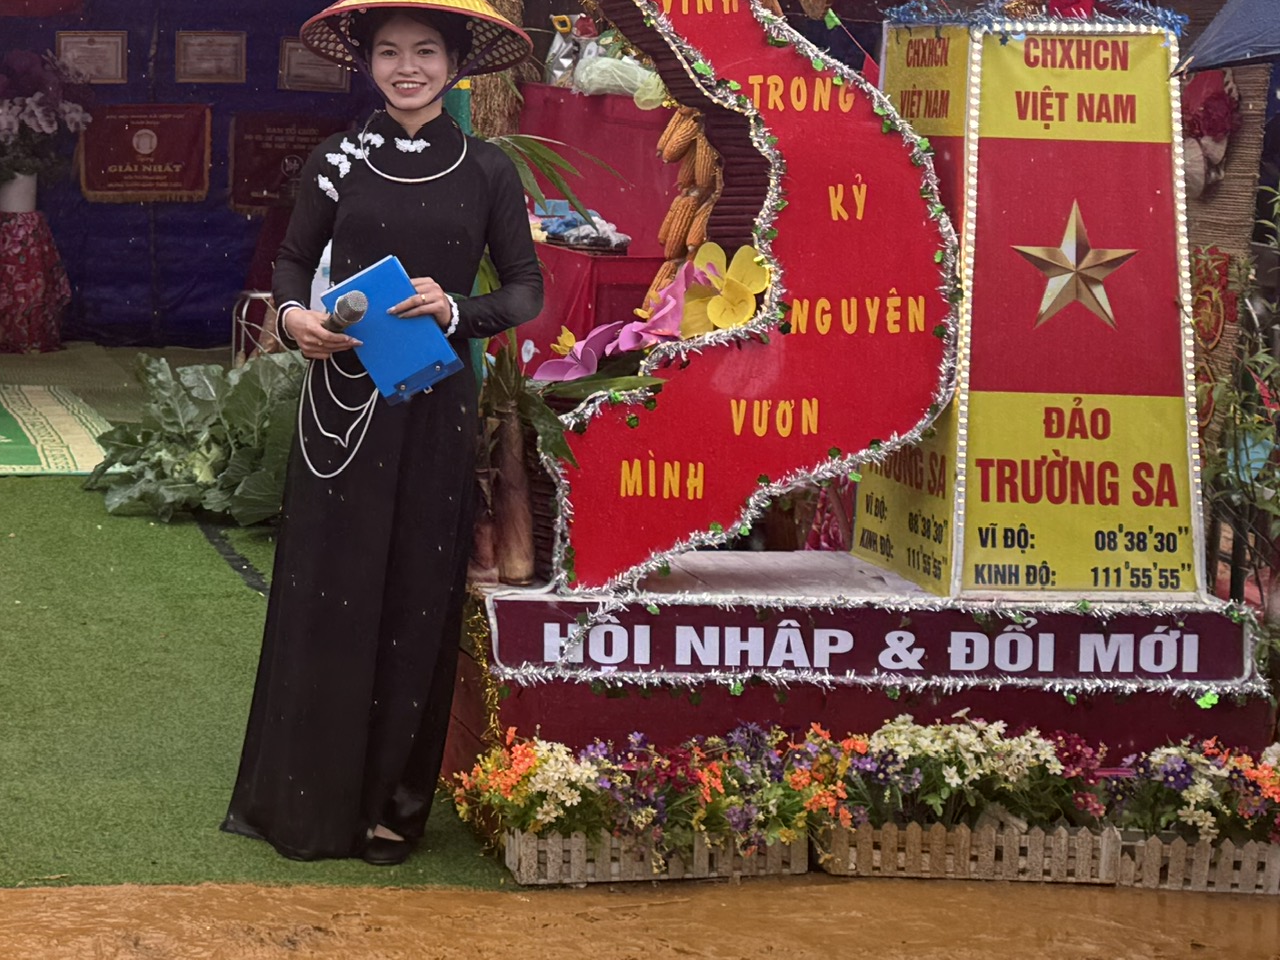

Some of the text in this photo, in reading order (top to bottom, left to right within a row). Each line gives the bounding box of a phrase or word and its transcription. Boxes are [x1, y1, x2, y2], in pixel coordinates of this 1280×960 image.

[907, 37, 948, 68] CHXHCN
[1023, 38, 1129, 72] CHXHCN
[748, 75, 855, 112] TRONG
[923, 89, 950, 119] NAM
[1015, 86, 1136, 130] VIỆT NAM
[828, 174, 867, 221] KỶ
[790, 288, 926, 335] NGUYÊN
[730, 398, 819, 437] VƯƠN
[1043, 397, 1111, 440] ĐẢO
[620, 450, 705, 499] MÌNH
[927, 451, 947, 500] SA
[975, 449, 1179, 507] TRƯỜNG SA
[977, 525, 998, 550] VĨ
[1003, 523, 1036, 555] ĐỘ:
[974, 564, 1019, 586] KINH
[1025, 561, 1057, 591] ĐỘ:
[543, 614, 651, 673] HỘI
[878, 631, 925, 671] &
[948, 618, 1054, 672] ĐỔI
[1078, 625, 1199, 673] MỚI
